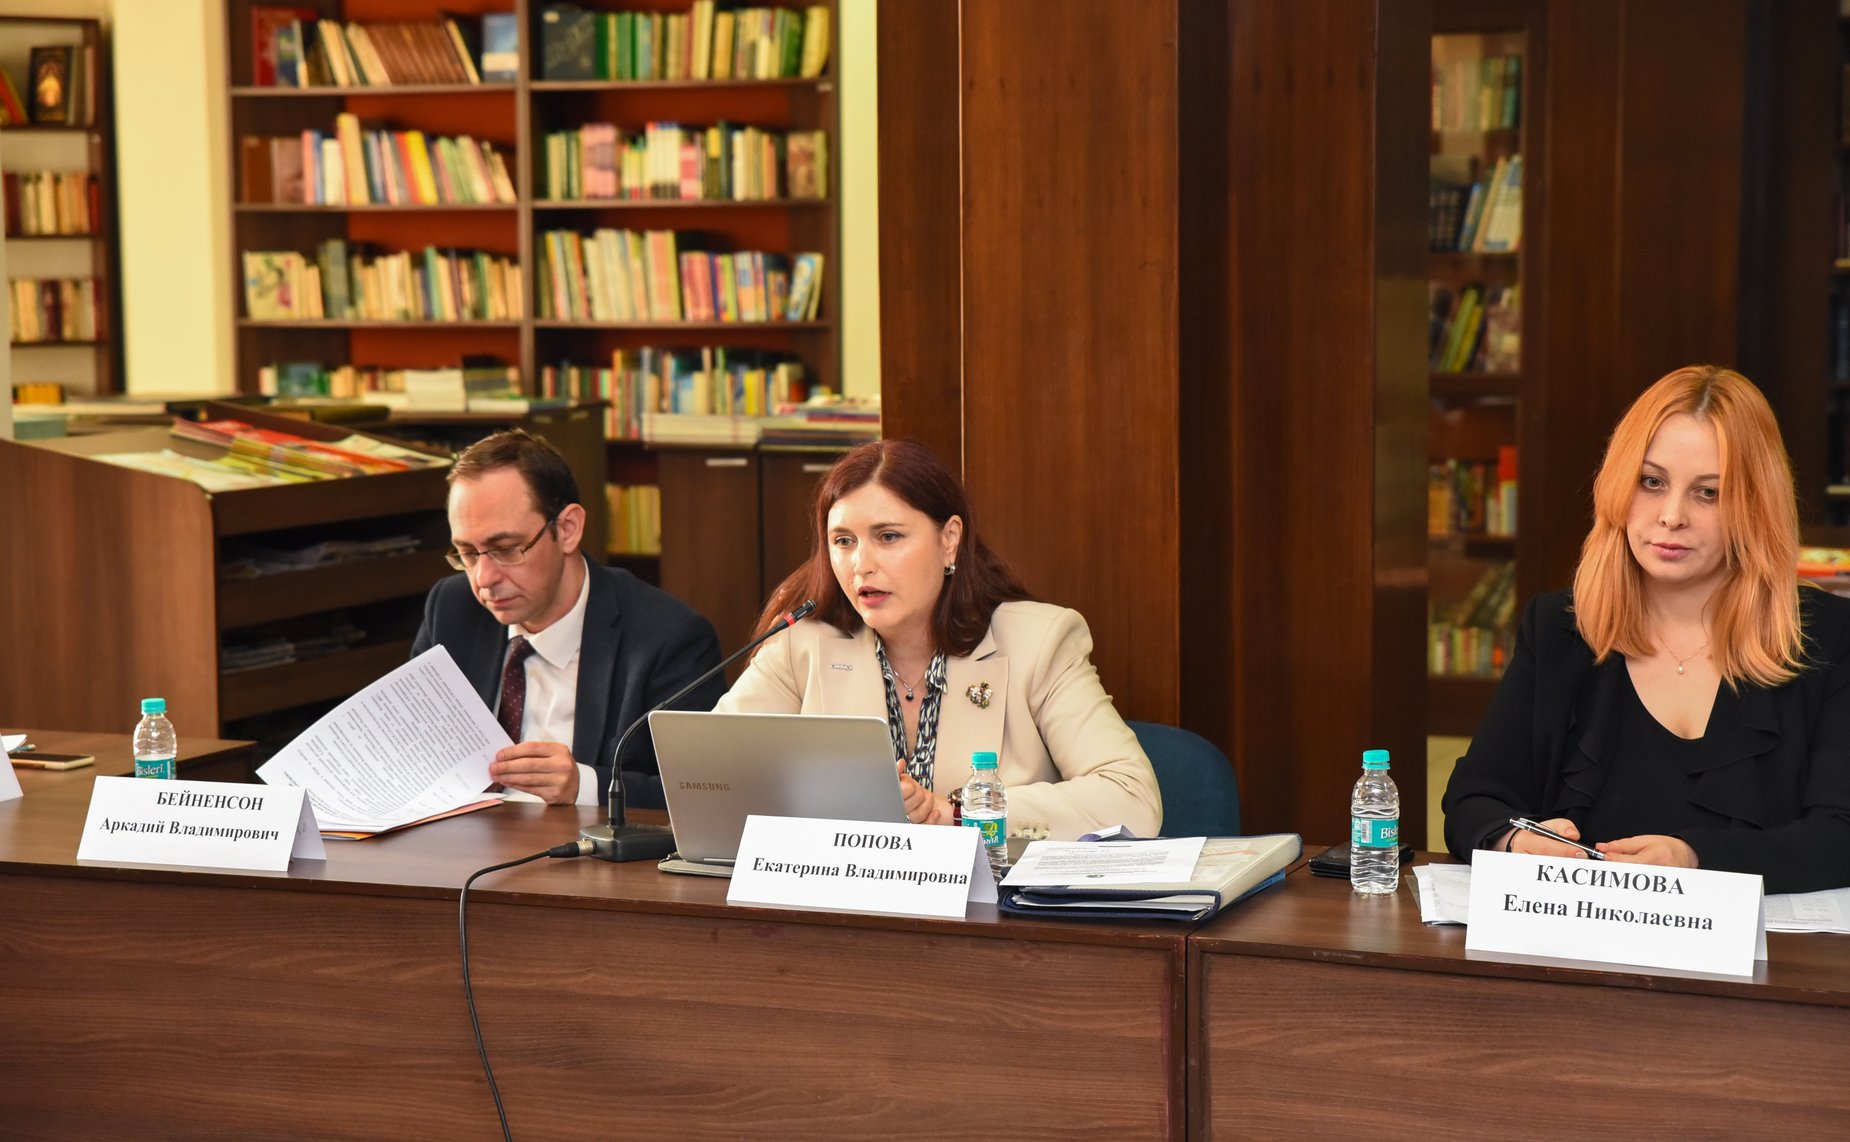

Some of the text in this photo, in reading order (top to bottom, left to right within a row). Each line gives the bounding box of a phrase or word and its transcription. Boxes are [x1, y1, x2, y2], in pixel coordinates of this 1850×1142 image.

[679, 781, 730, 791] SAMSUNG
[156, 790, 264, 811] БЕЙНЕНСОН
[99, 817, 280, 842] Аркадий Владимирович
[833, 832, 913, 851] ПОПОВА
[752, 857, 968, 886] Екатерина Владимировна
[1536, 864, 1686, 895] КАСИМОВА
[1502, 893, 1714, 930] Елена Николаевна
